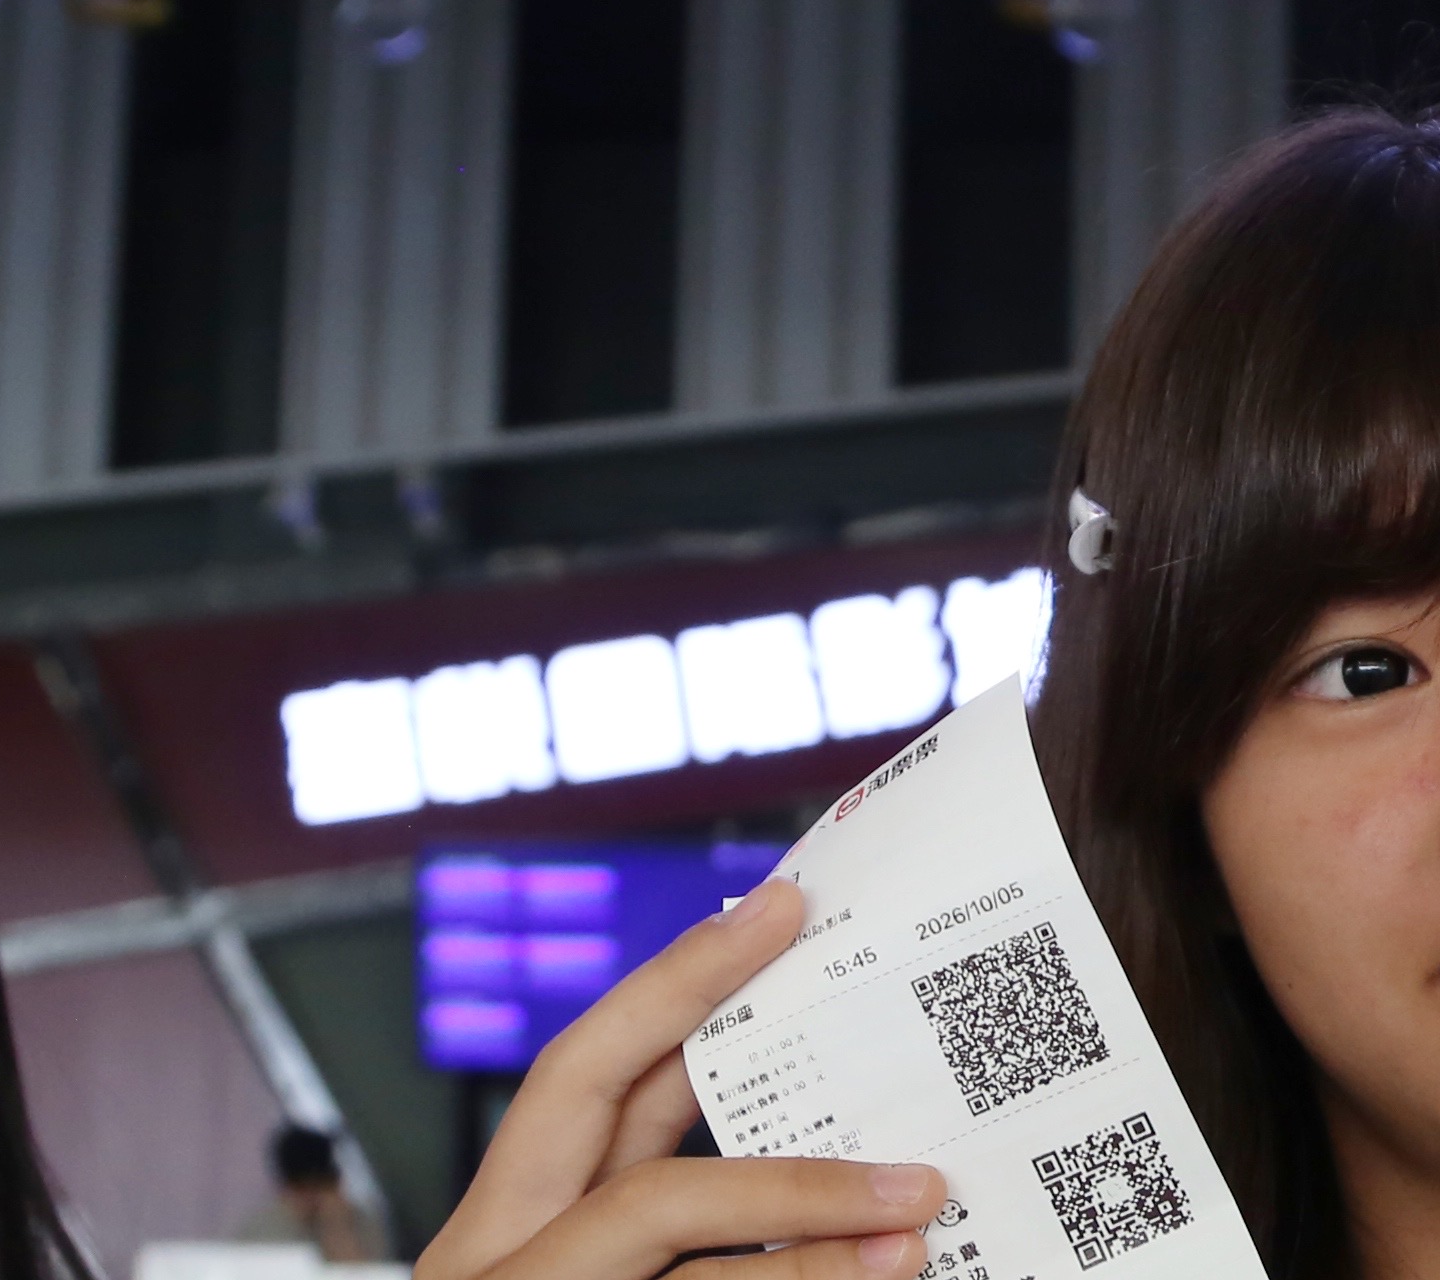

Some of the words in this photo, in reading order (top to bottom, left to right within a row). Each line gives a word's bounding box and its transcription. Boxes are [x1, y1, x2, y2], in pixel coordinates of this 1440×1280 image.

[698, 1004, 754, 1042] 3排5座
[823, 946, 877, 980] 15:45
[915, 881, 1024, 941] 2026/10/05
